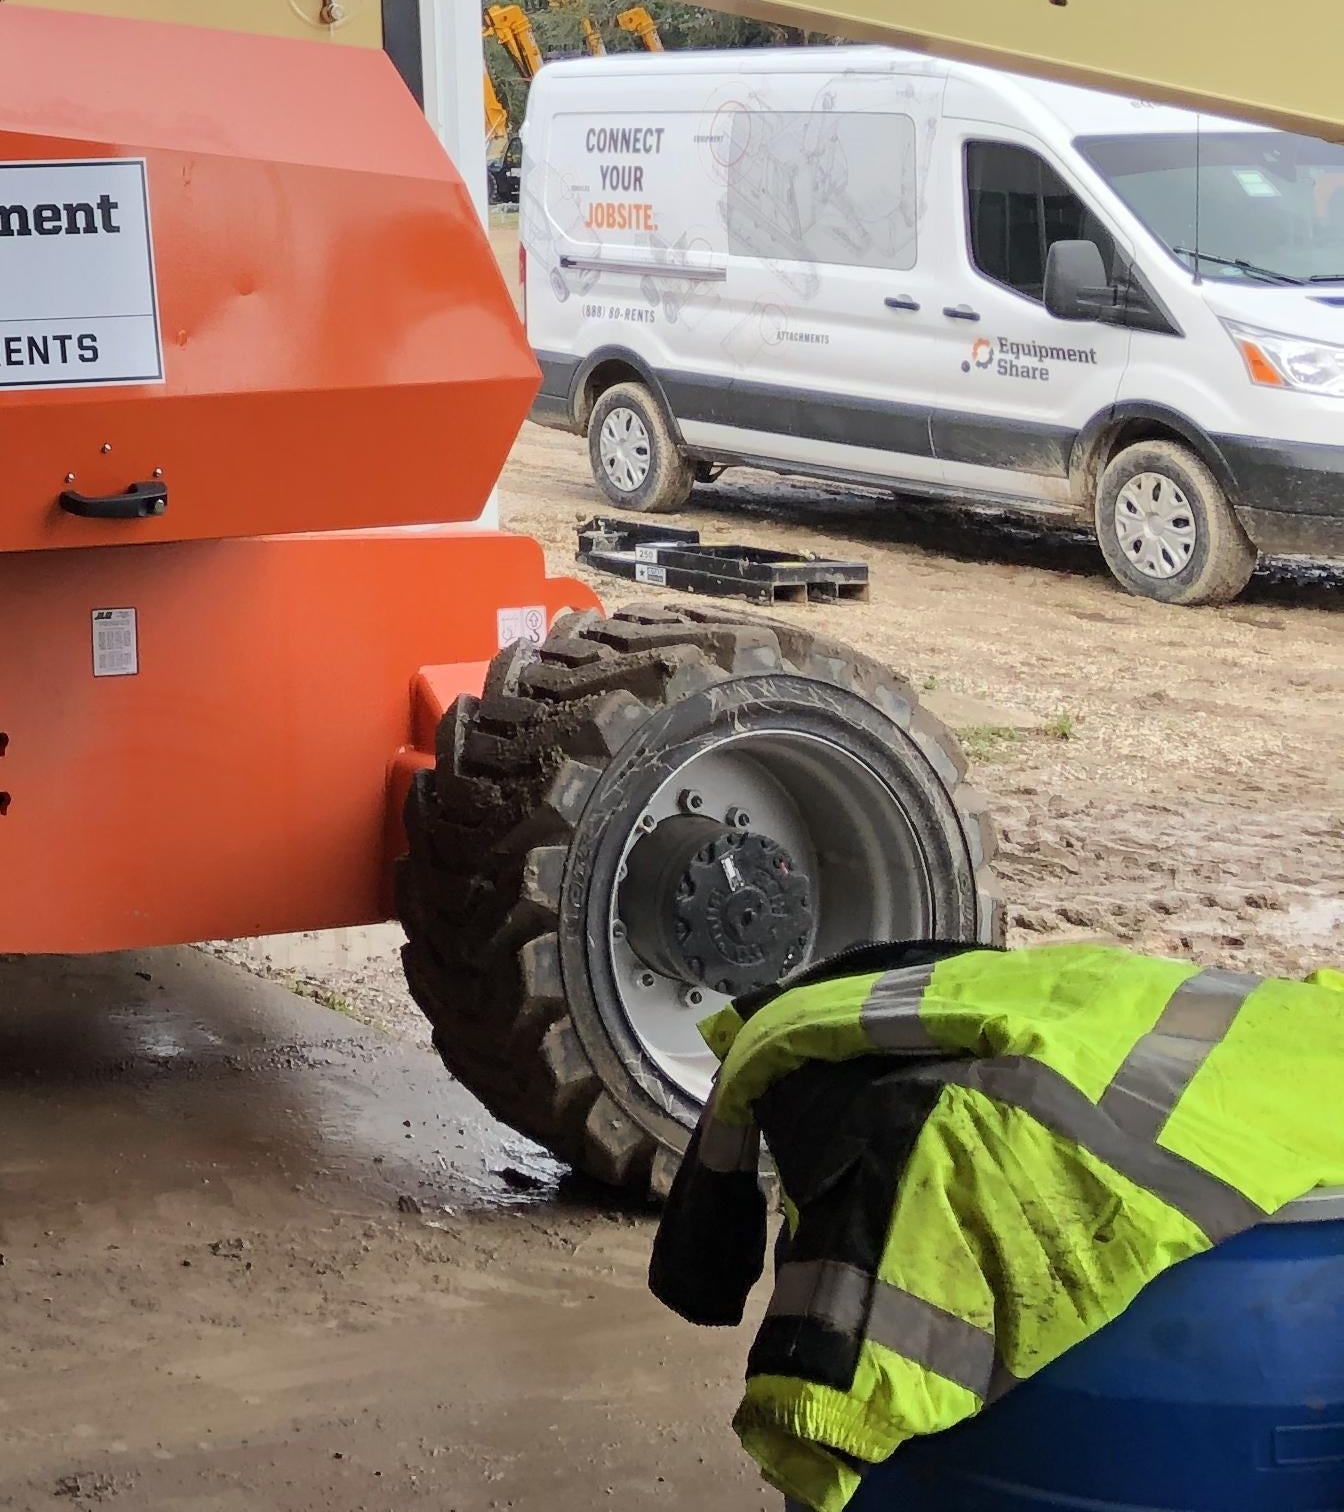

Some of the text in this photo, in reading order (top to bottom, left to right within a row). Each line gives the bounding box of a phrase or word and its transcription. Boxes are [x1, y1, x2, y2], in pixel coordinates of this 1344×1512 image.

[585, 127, 665, 154] CONNECT
[599, 165, 645, 192] YOUR
[584, 202, 659, 232] JOBSITE.
[582, 303, 656, 324] (888) 80-RENTS
[776, 329, 830, 345] ATTACHMENTS
[997, 336, 1098, 365] Equipment
[997, 359, 1050, 381] Share
